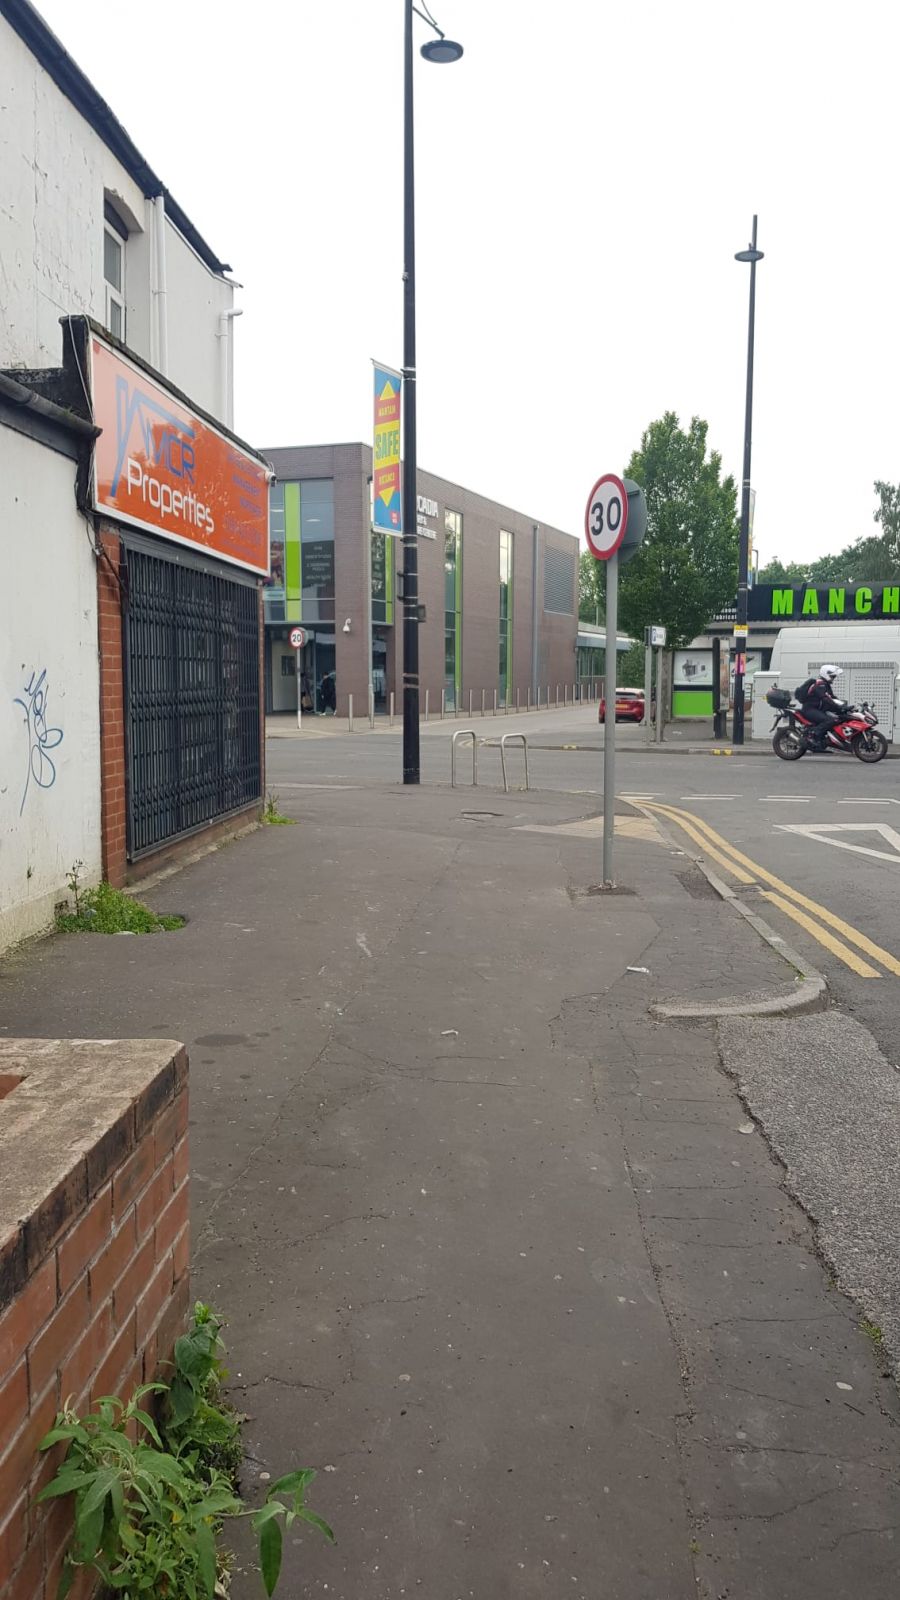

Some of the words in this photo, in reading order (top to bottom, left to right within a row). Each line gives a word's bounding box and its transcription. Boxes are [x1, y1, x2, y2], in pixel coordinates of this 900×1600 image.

[375, 430, 400, 460] SAFE
[127, 457, 216, 534] Properties
[416, 495, 439, 519] CADIA
[591, 496, 622, 536] 30
[771, 586, 900, 615] MANCH
[291, 634, 302, 643] 20
